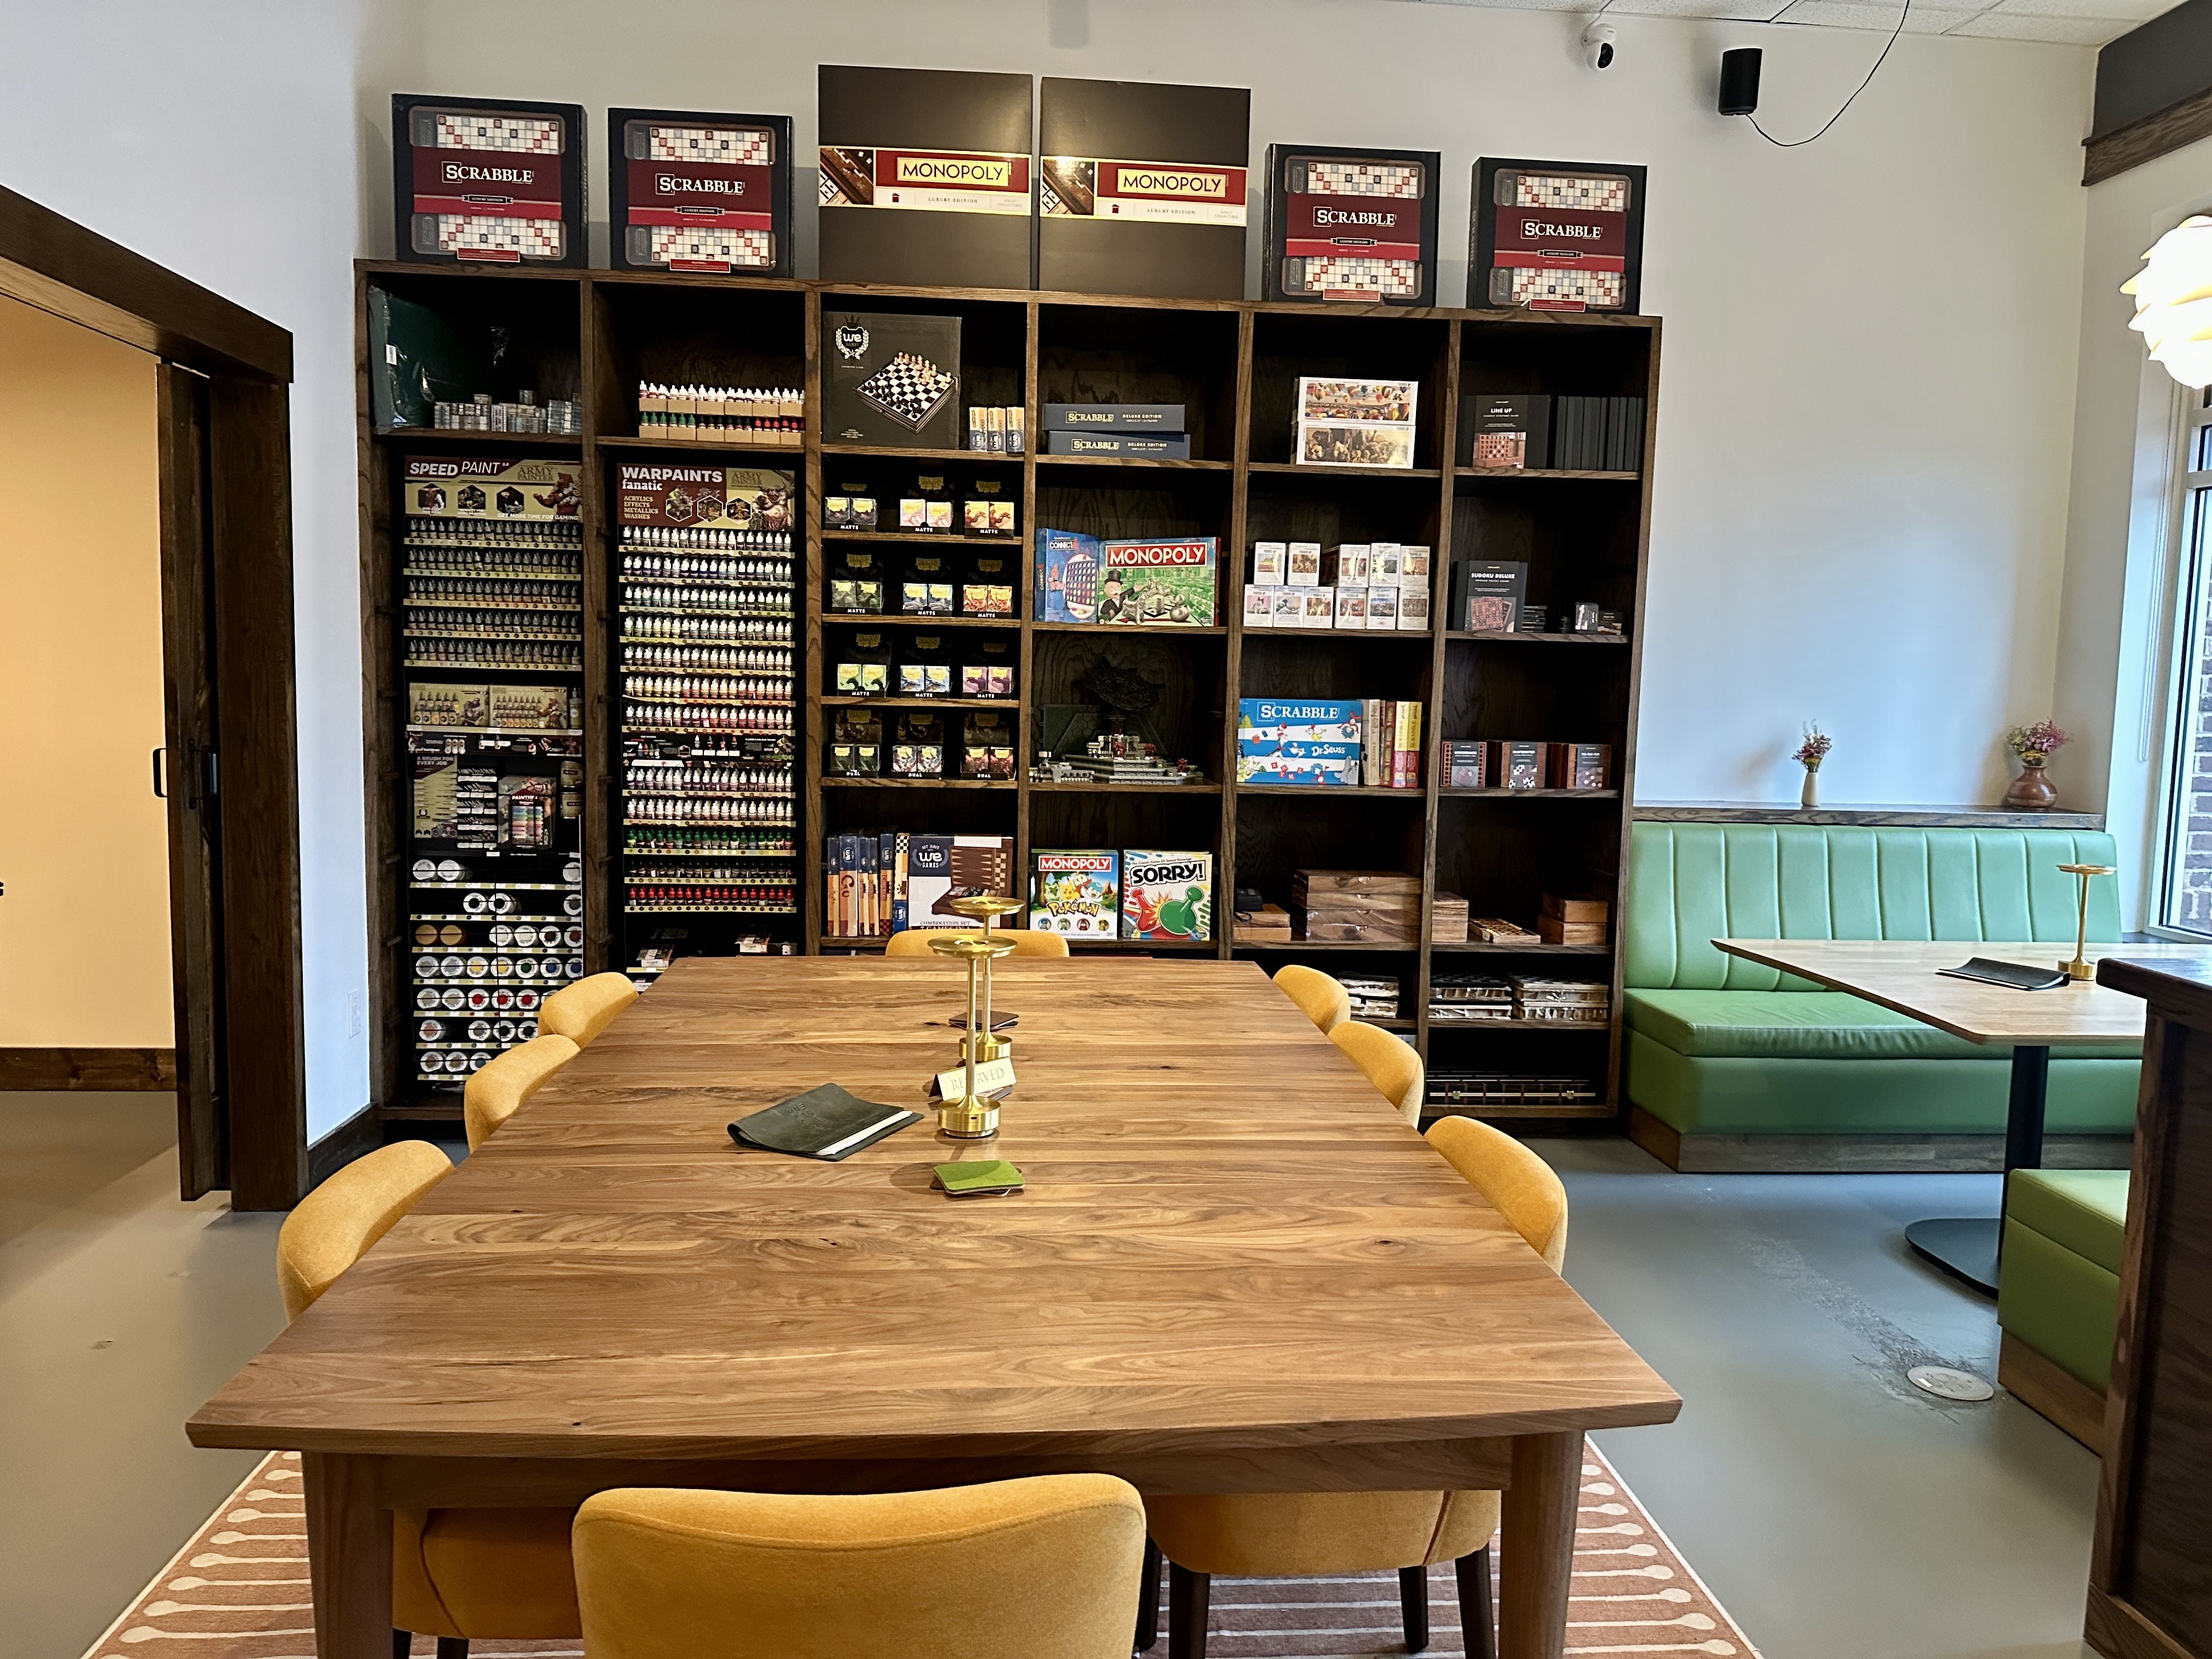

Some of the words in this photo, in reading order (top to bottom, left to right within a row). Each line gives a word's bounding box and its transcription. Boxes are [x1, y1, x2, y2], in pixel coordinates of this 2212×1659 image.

[446, 165, 533, 182] SCRABBLE
[903, 162, 1003, 180] MONOPOLY
[659, 177, 744, 194] SCRABBLE
[1124, 174, 1221, 192] MONOPOLY
[1317, 210, 1396, 225] SCRABBLE
[1525, 222, 1601, 239] SCRABBLE
[843, 333, 862, 342] we
[1068, 413, 1114, 422] SCRABBLE
[1073, 440, 1119, 450] SCRABBLE
[410, 462, 458, 476] SPEED
[461, 461, 500, 474] PAINT
[518, 466, 555, 475] ARMY
[622, 466, 723, 483] WARPAINTS
[732, 471, 762, 479] ARMY
[622, 478, 663, 491] fanatic
[1109, 546, 1204, 565] MONOPOLY
[1261, 705, 1338, 719] SCRABBLE
[919, 852, 943, 862] we
[1041, 858, 1110, 870] MONOPOLY
[1132, 863, 1203, 884] SORRY!
[951, 1068, 1005, 1091] RERVED
